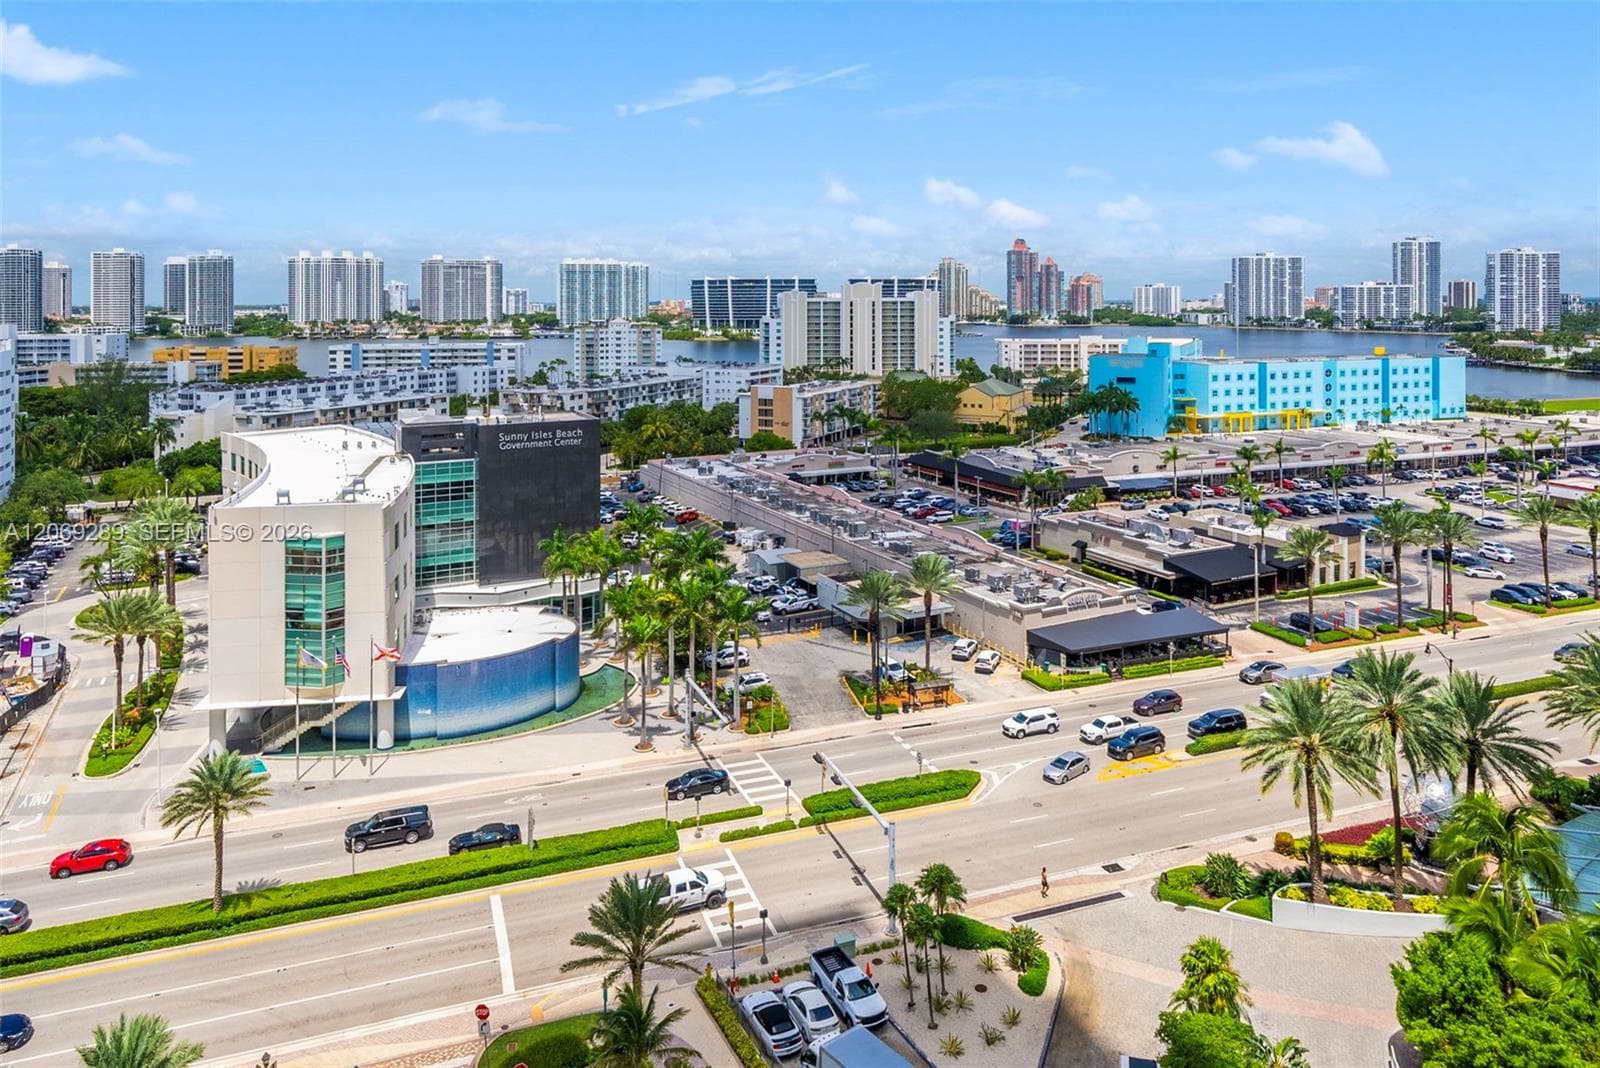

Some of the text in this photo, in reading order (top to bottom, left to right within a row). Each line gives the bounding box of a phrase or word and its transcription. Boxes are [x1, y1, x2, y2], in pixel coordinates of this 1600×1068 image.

[498, 428, 583, 441] Sunny Isles Beach
[499, 438, 582, 450] Government Center
[18, 790, 54, 808] ONLY
[476, 1008, 489, 1016] STOP
